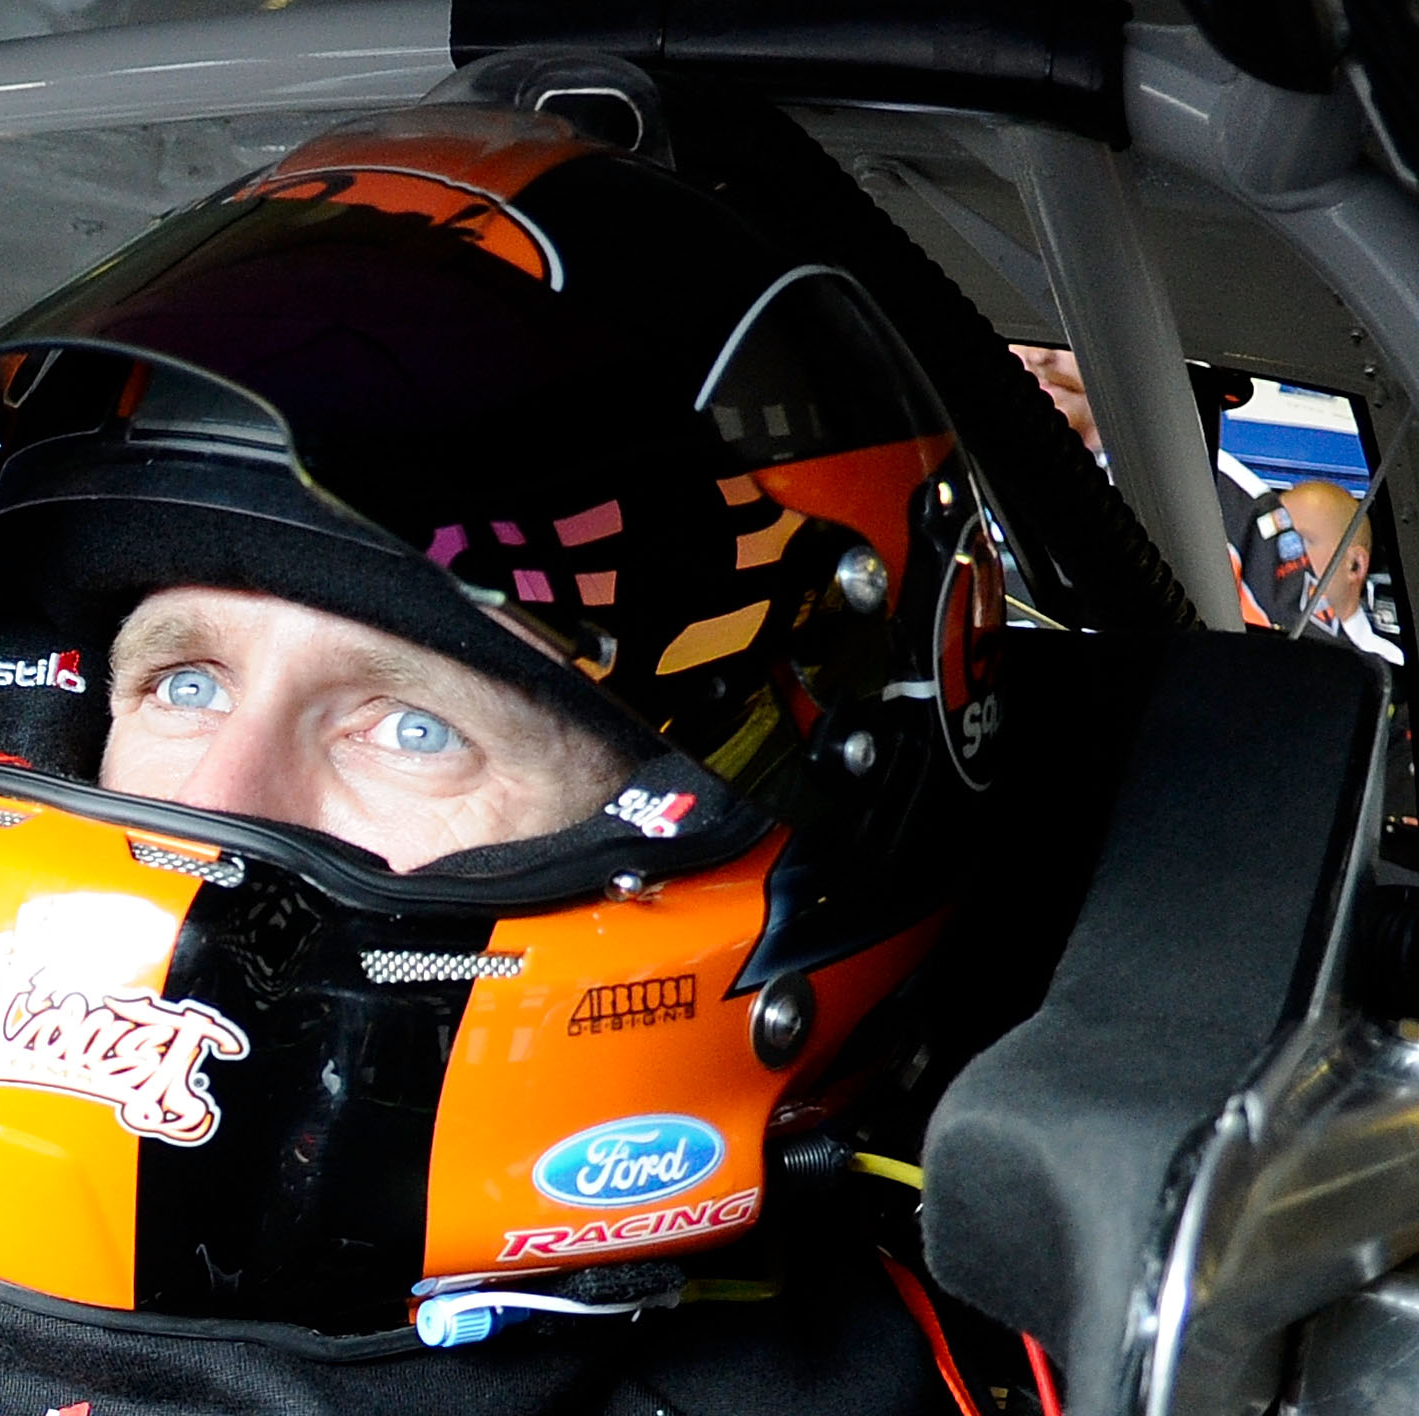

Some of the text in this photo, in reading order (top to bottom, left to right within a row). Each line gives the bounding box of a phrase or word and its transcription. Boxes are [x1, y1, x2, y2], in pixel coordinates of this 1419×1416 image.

[603, 788, 695, 838] Stilo
[575, 1129, 688, 1196] Ford
[495, 1186, 760, 1263] RACING
